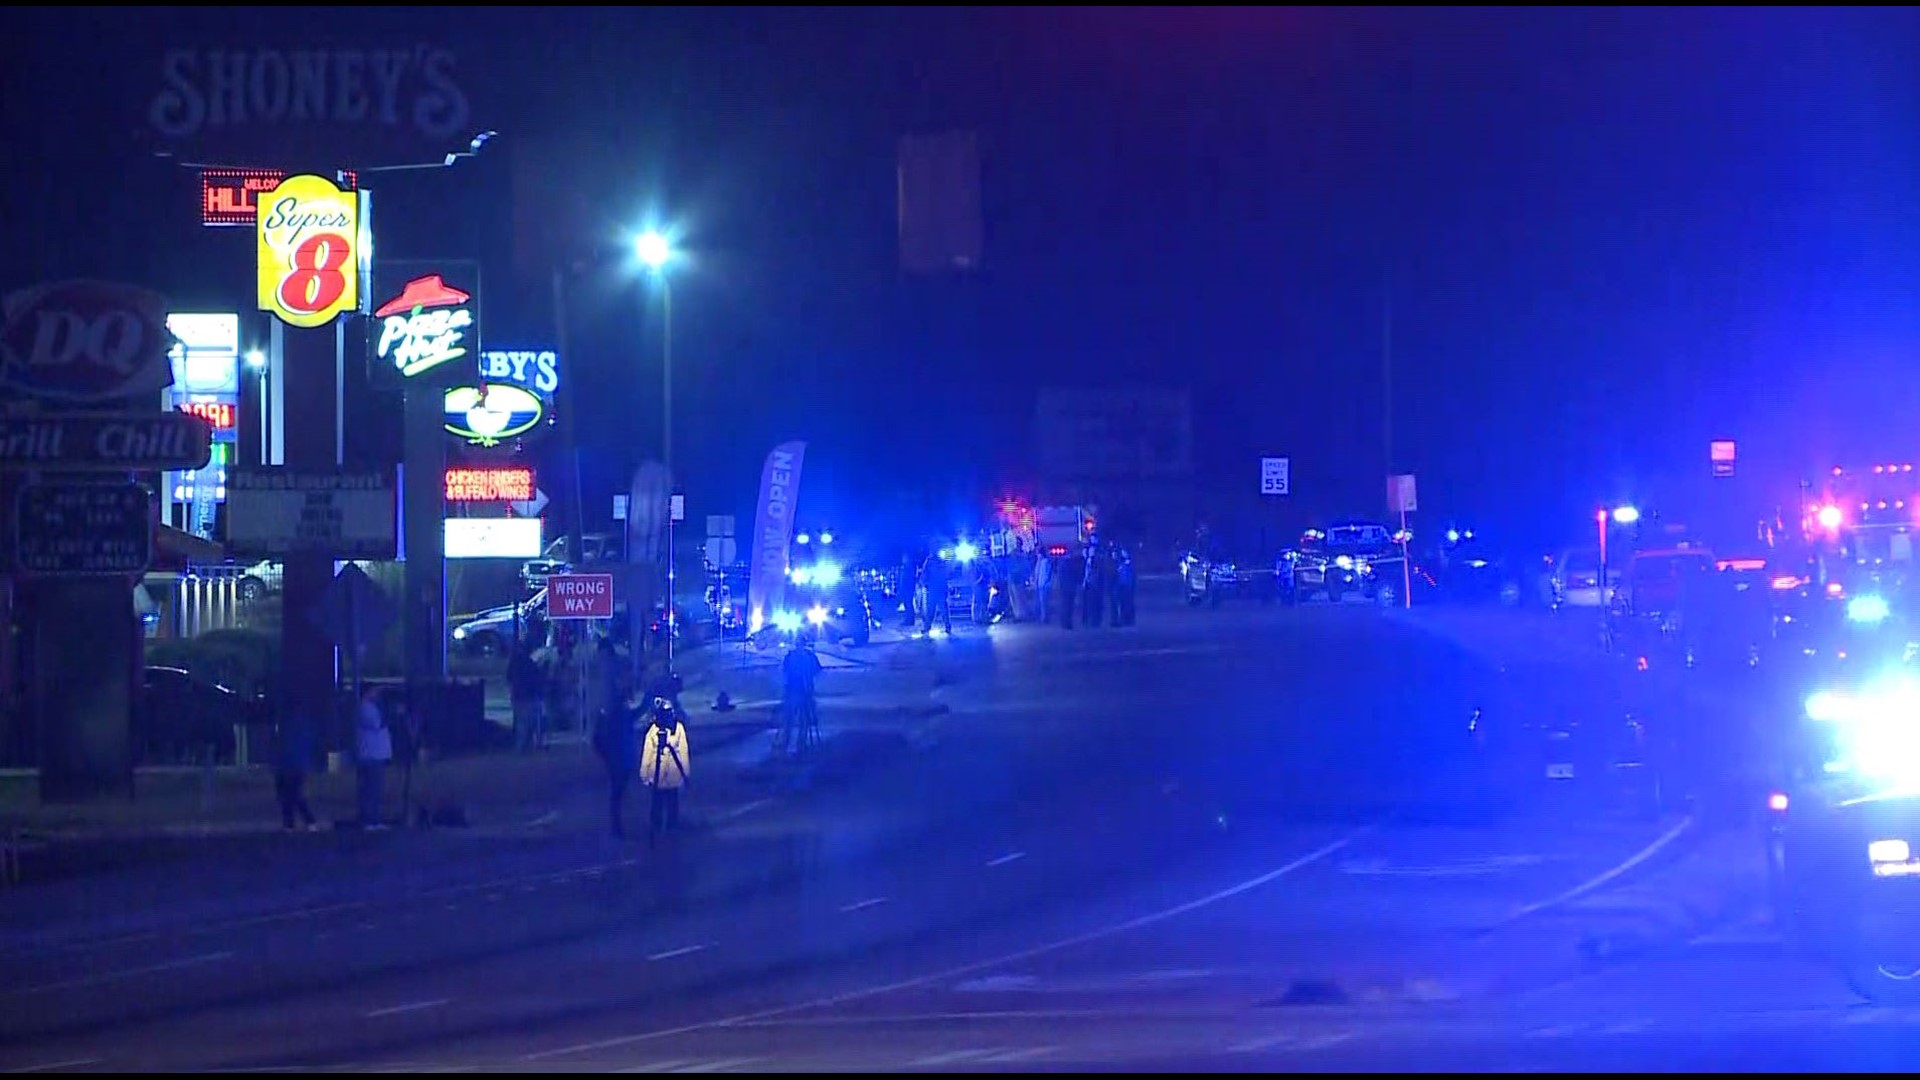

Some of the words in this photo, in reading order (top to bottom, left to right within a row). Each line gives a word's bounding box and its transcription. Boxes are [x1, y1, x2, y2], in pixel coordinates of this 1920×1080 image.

[151, 44, 469, 136] SHONEY'S
[265, 197, 350, 245] Super
[277, 233, 350, 315] 8
[31, 312, 144, 379] DQ
[378, 305, 472, 358] Pizza
[394, 329, 463, 369] Hut
[481, 351, 558, 392] BY'S
[97, 423, 187, 458] Chill
[235, 472, 384, 490] Restaurant
[446, 470, 487, 485] CHICKEN
[488, 470, 530, 485] FINGERS
[455, 485, 497, 500] BUFFALO
[498, 485, 529, 500] WINGS
[768, 451, 793, 519] OPEN
[1265, 478, 1285, 490] 55
[555, 582, 605, 595] WRONG
[564, 599, 594, 611] WAY
